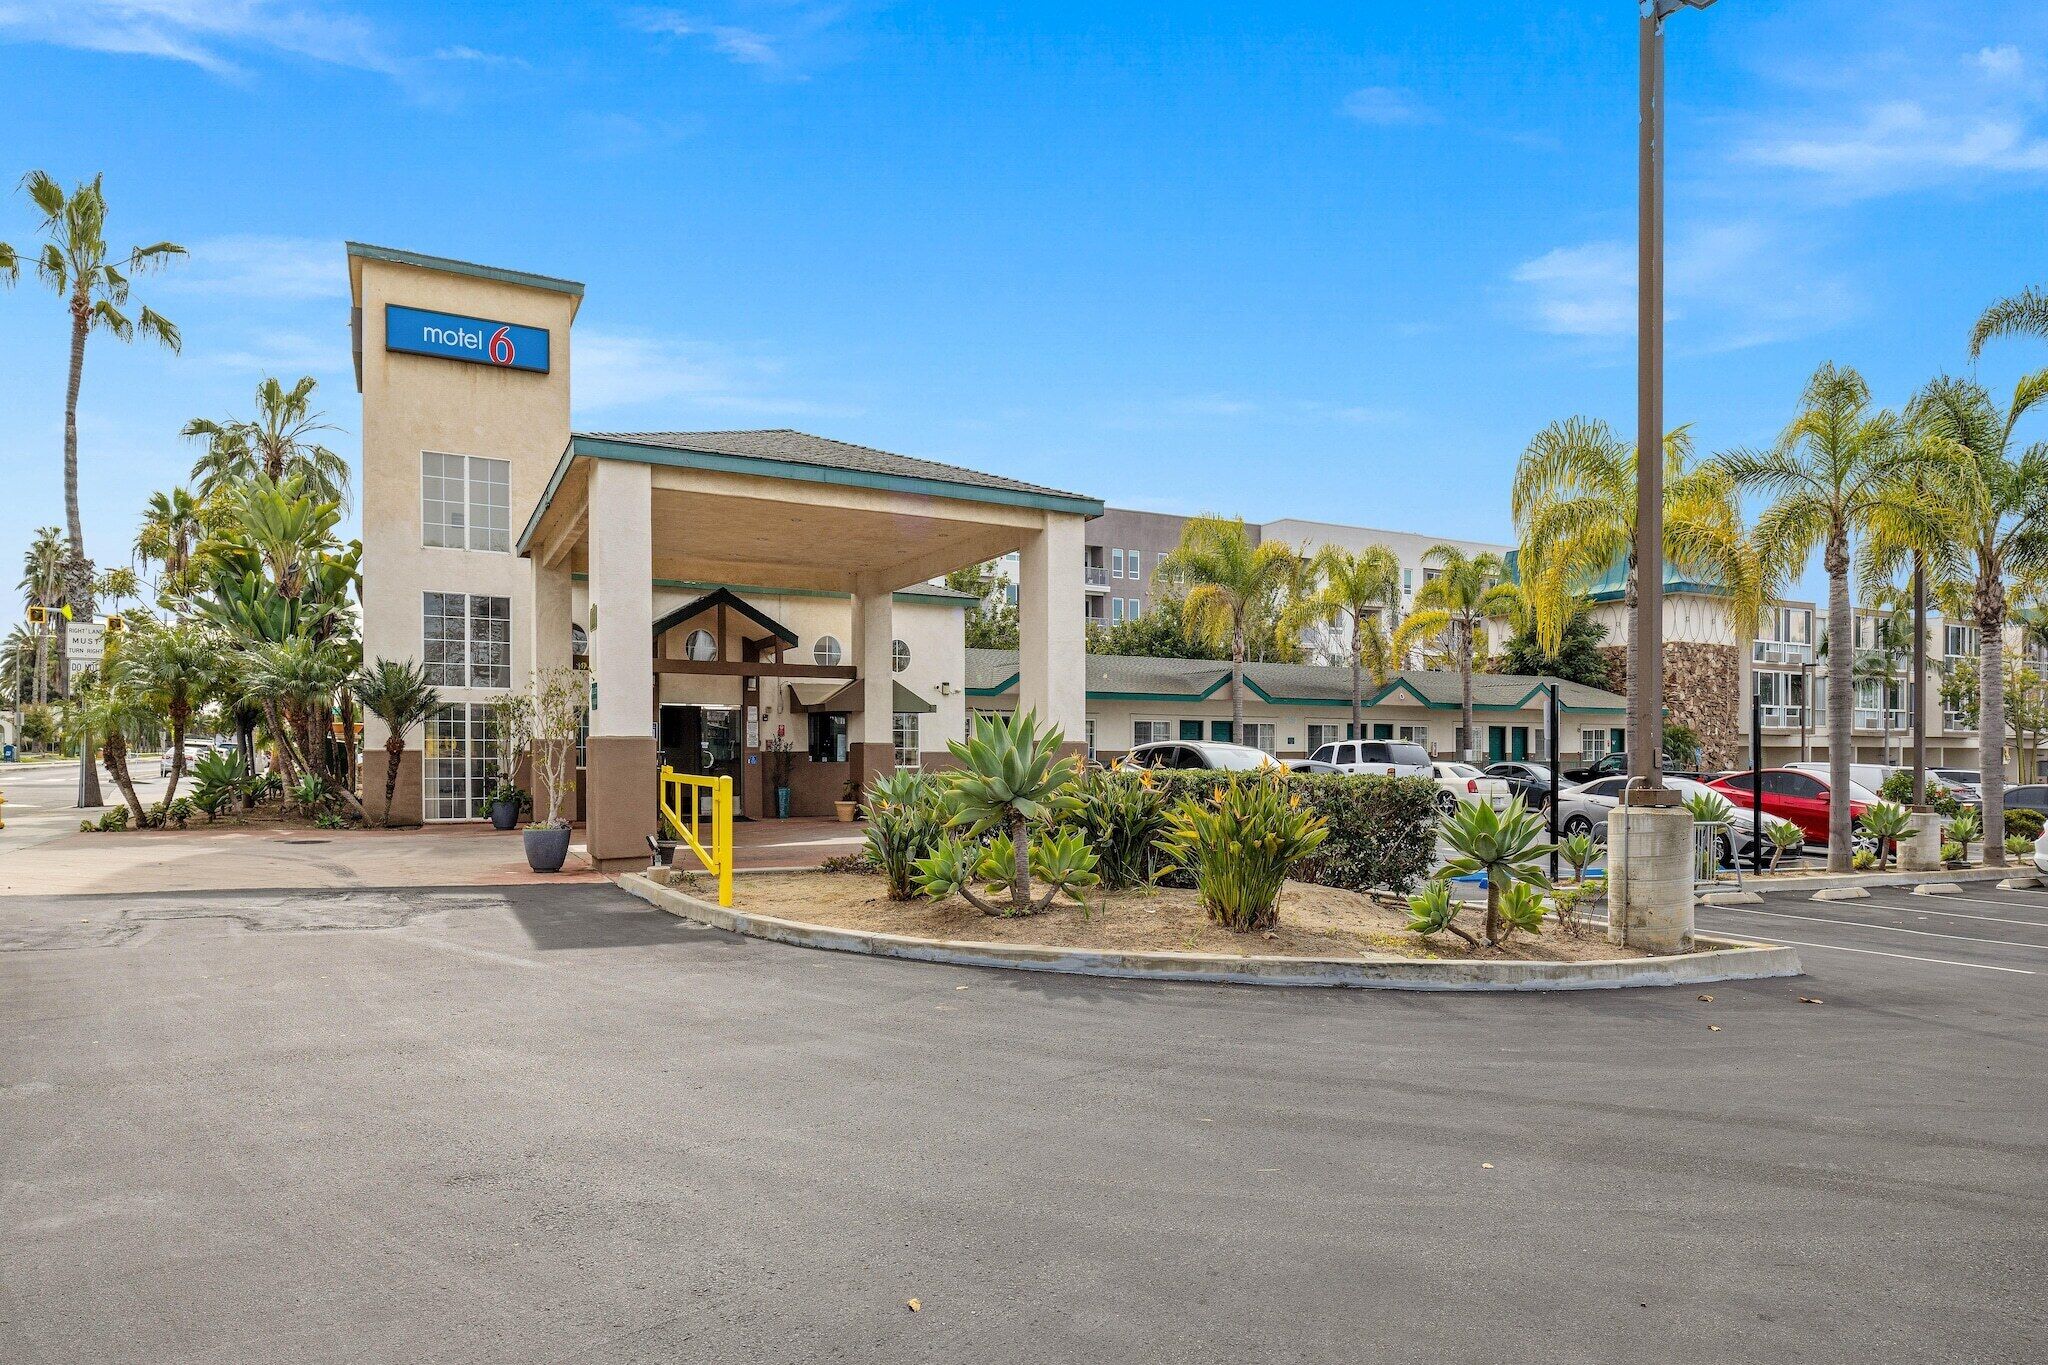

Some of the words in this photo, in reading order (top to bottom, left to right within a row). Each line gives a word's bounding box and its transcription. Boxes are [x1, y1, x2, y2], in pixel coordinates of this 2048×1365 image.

[423, 326, 483, 350] motel
[488, 326, 516, 366] 6
[72, 637, 99, 645] MUST
[71, 662, 82, 671] DO
